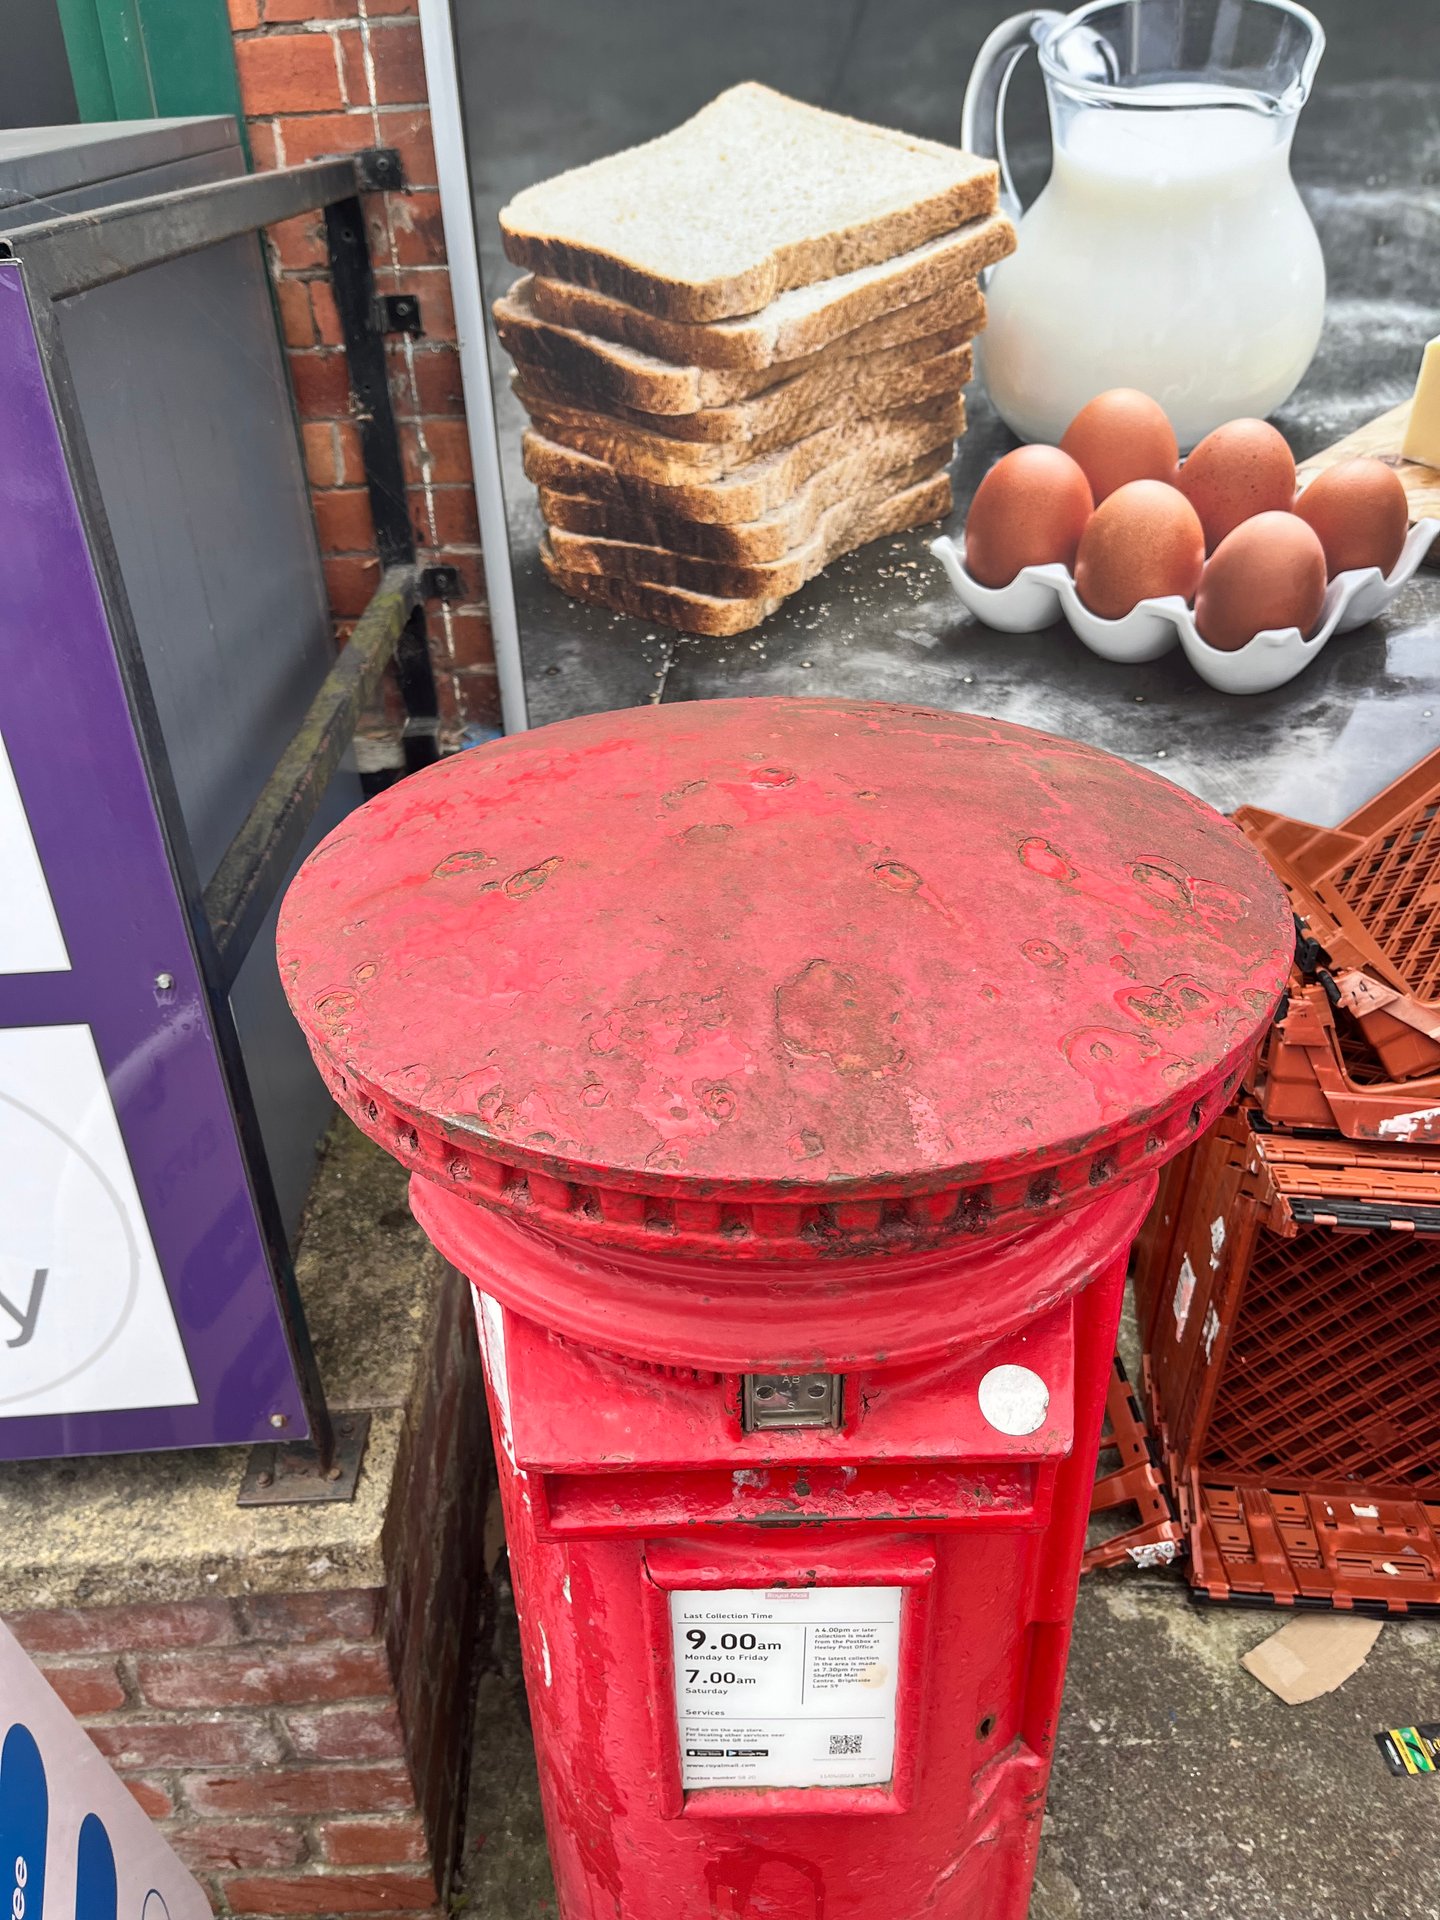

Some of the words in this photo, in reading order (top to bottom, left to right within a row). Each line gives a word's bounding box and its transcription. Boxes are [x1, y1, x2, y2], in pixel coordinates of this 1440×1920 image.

[767, 1592, 789, 1600] Royal
[685, 1629, 782, 1650] 9.00am
[684, 1654, 723, 1662] Monday
[738, 1654, 769, 1662] Friday
[685, 1669, 757, 1684] 7.00am
[685, 1687, 729, 1695] Saturday
[685, 1708, 726, 1716] Services
